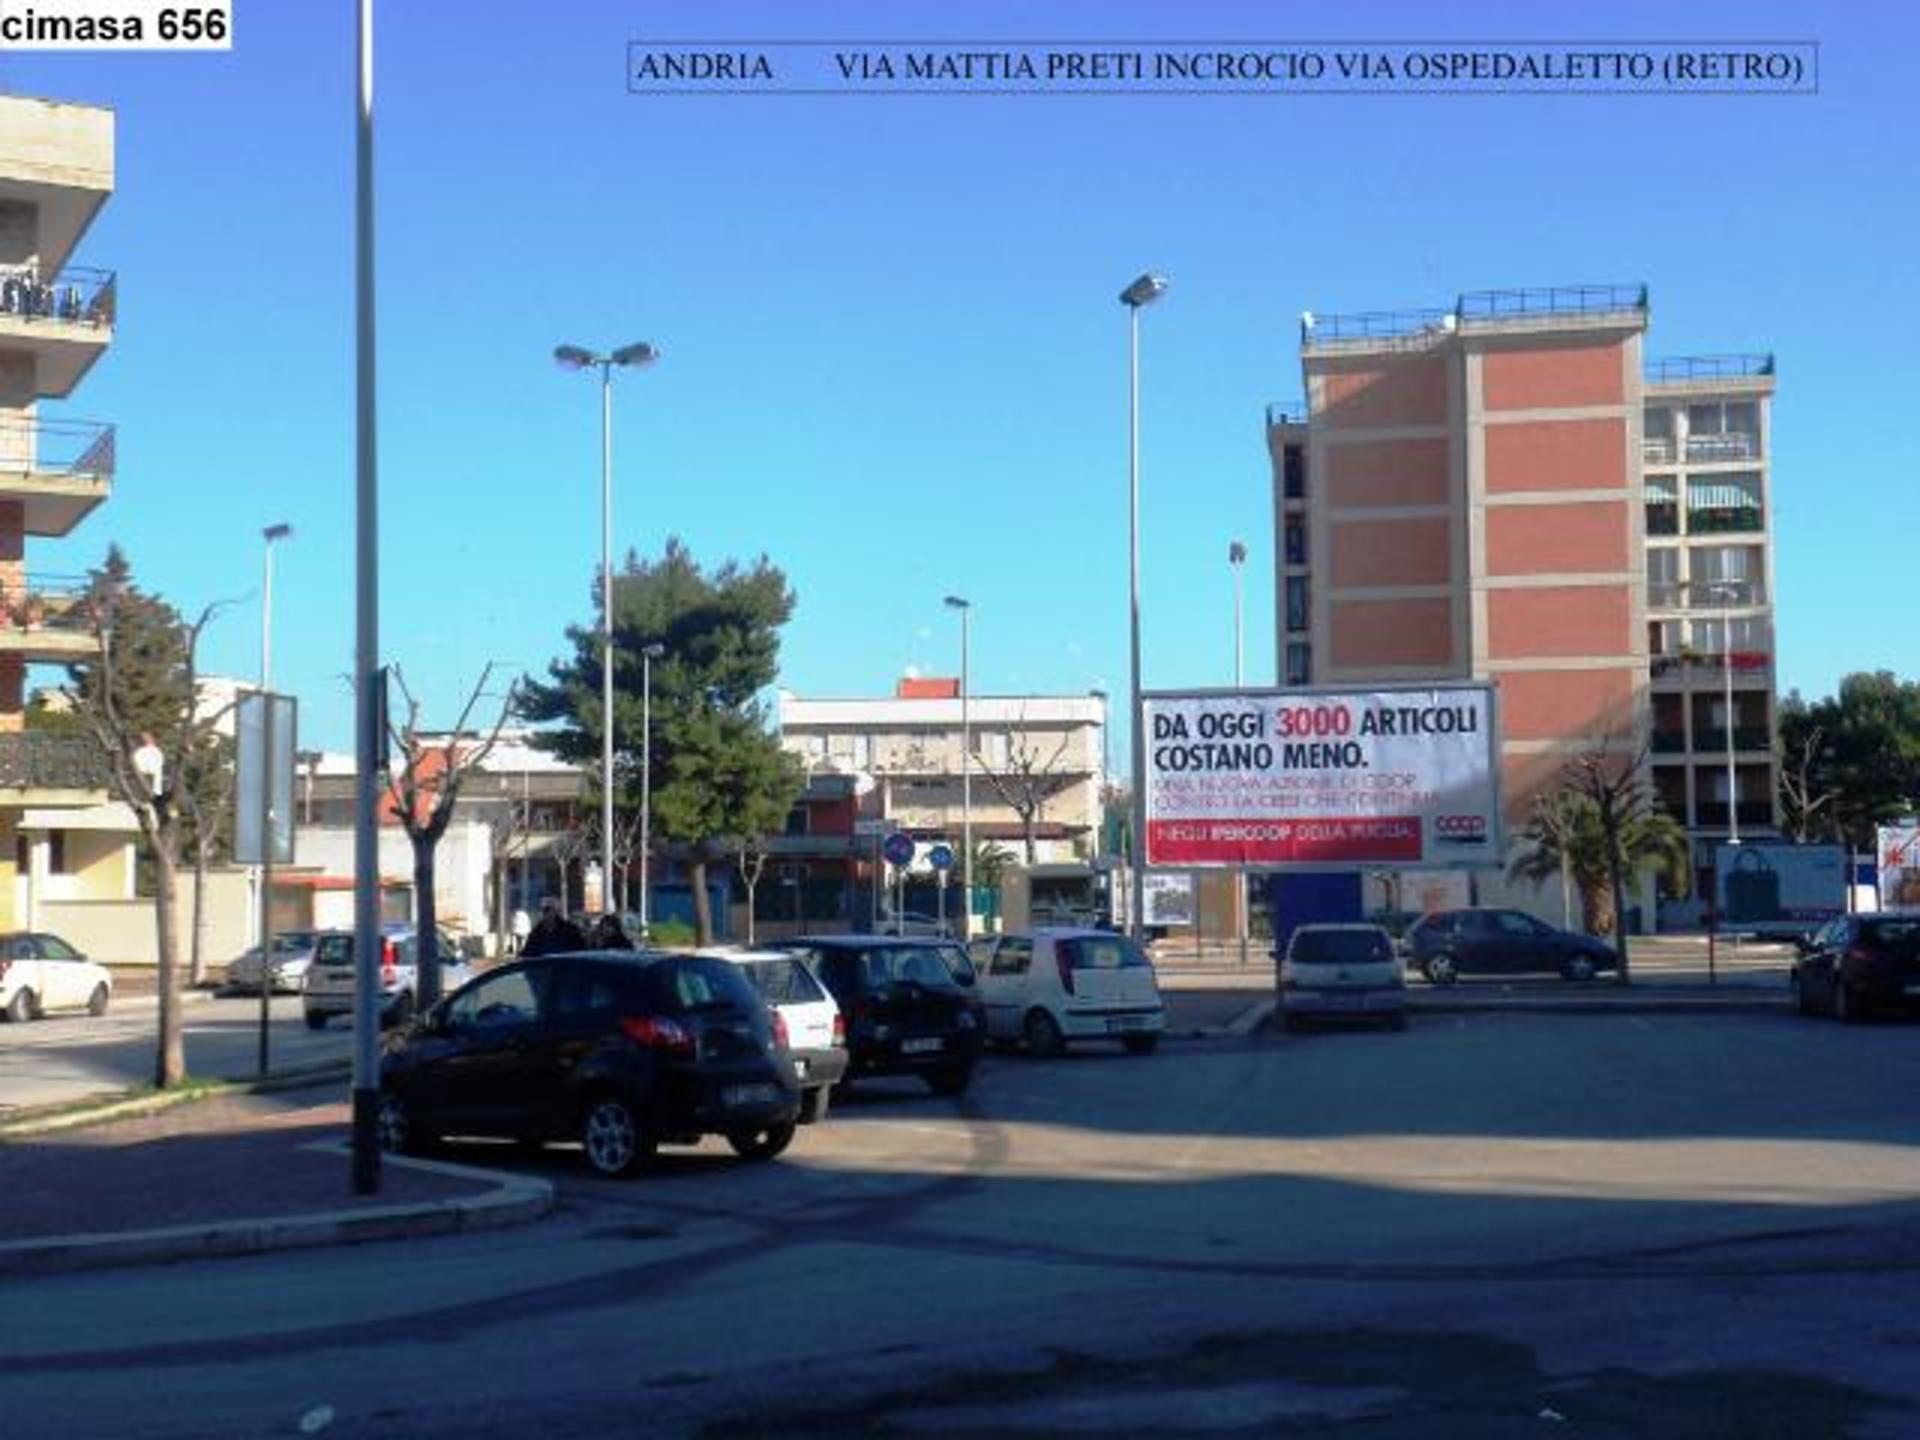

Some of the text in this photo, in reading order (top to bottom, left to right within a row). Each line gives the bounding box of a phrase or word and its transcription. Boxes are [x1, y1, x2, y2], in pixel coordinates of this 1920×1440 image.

[1154, 705, 1477, 740] DA OGGI 3000 ARTICOLI
[1154, 740, 1369, 772] COSTANO MENO.
